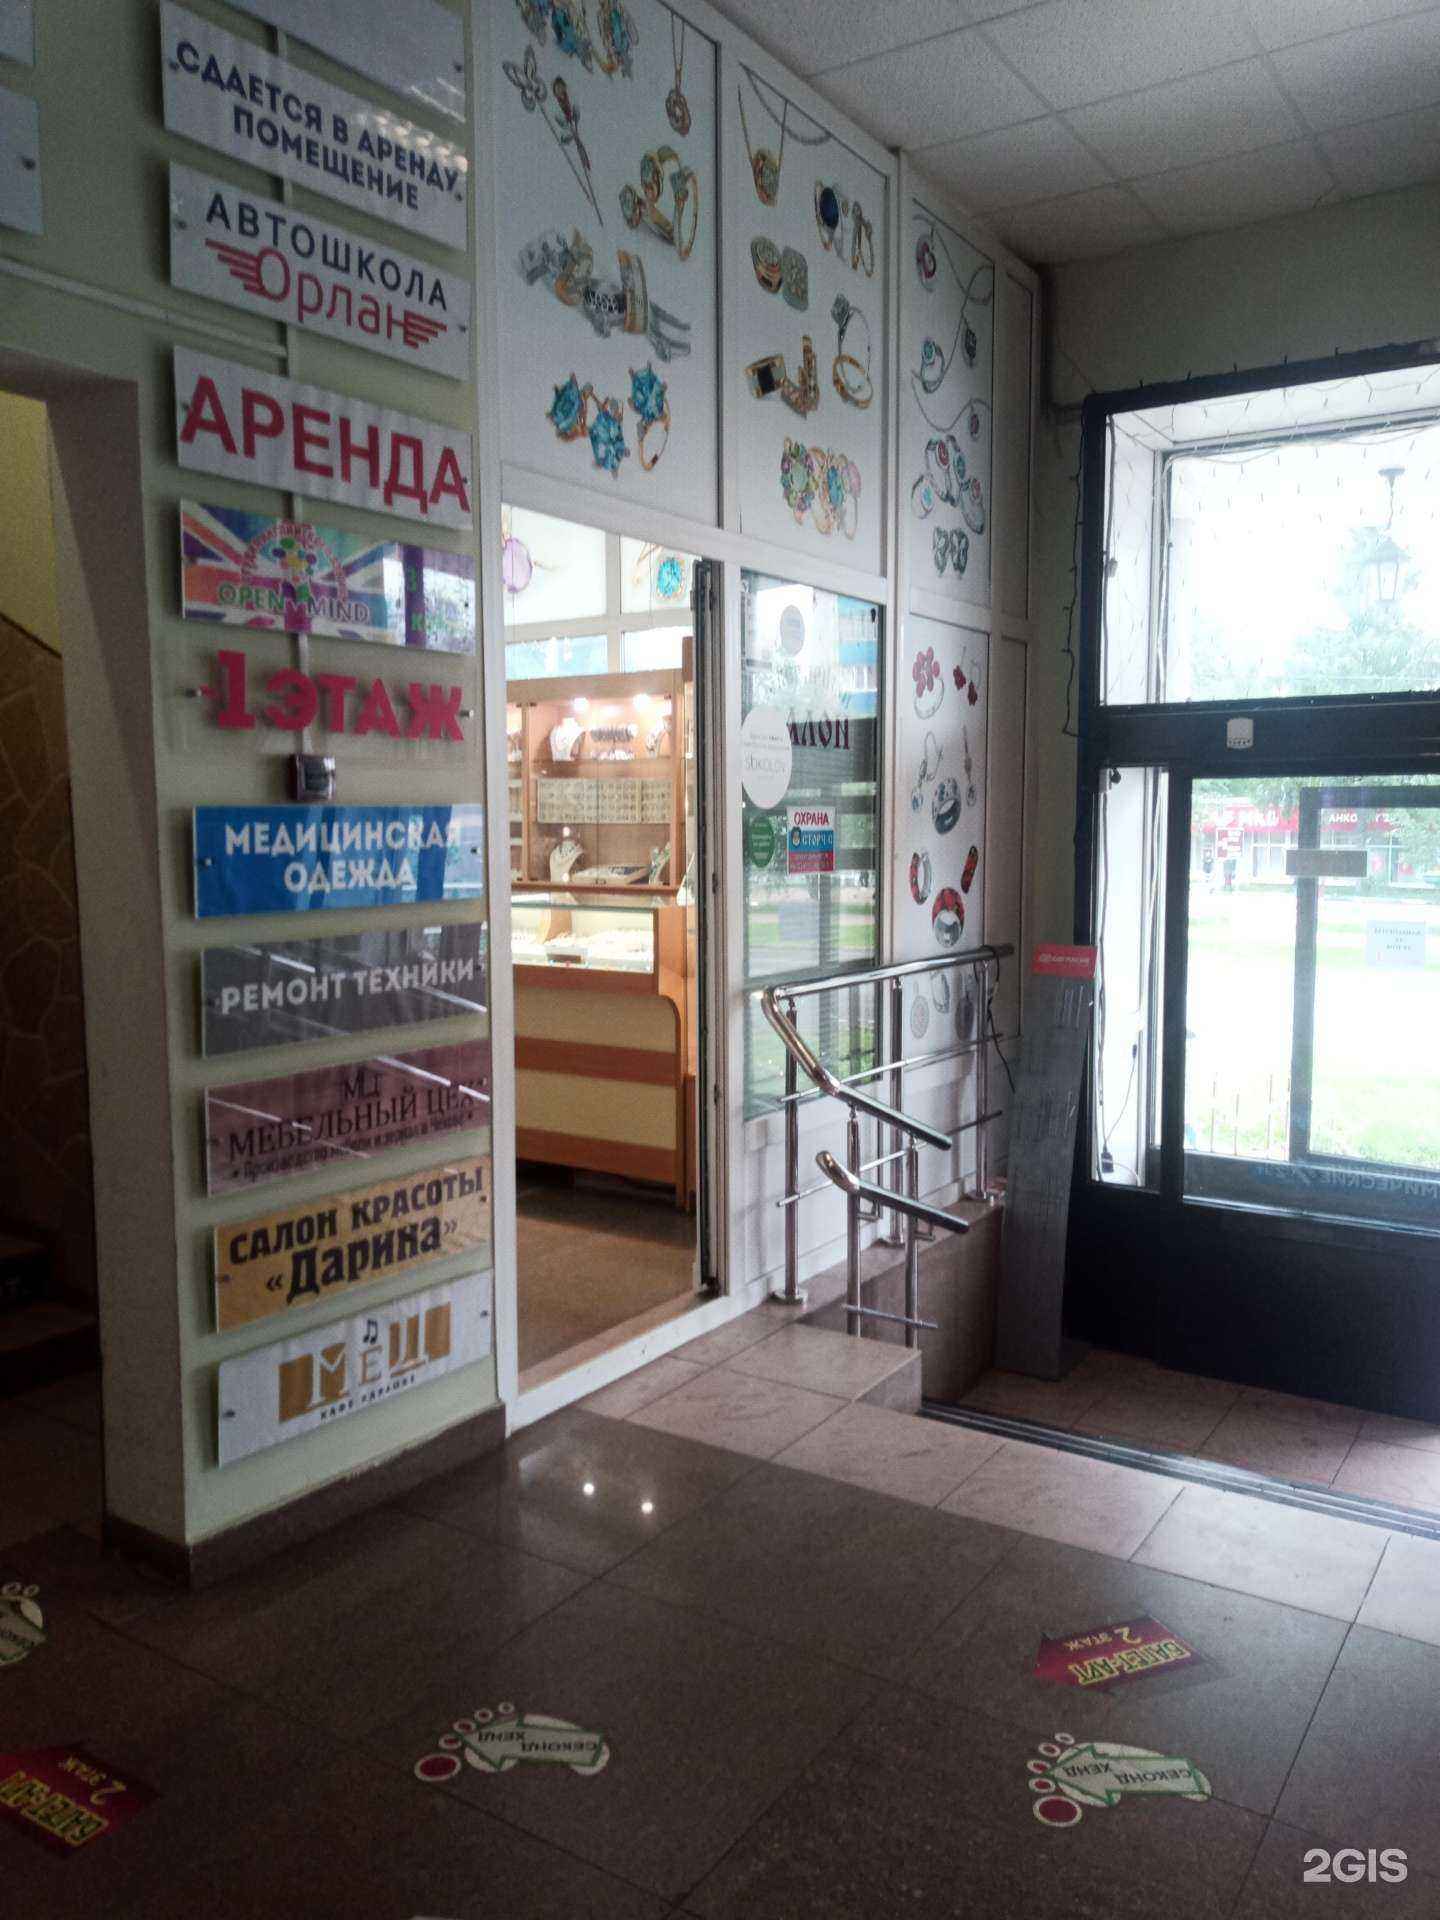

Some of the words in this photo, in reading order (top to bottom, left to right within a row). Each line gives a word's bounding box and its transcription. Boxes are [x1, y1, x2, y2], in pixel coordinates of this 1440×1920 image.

[176, 41, 322, 133] СДАЕТСЯ
[333, 114, 349, 145] В
[358, 130, 459, 192] АРЕНДУ
[233, 105, 419, 210] ПОМЕЩЕНИЕ
[206, 193, 447, 311] АВТОШКОЛА
[255, 246, 415, 346] Орлан
[179, 375, 471, 514] АРЕНДА
[218, 582, 285, 610] OPEN
[307, 596, 369, 622] MIND
[201, 650, 256, 730] 1
[265, 667, 464, 742] ЭТАЖ
[786, 707, 851, 751] АЛОН
[225, 821, 462, 855] МЕДИЦИНСКАЯ
[793, 811, 830, 827] ОХРАНА
[283, 856, 417, 893] ОДЕЖДА
[220, 972, 347, 1015] РЕМОНТ
[353, 957, 474, 996] ТЕХНИКИ
[228, 1085, 418, 1162] МЕБЕЛЬНЫЙ
[229, 1208, 338, 1265] САЛОН
[351, 1165, 483, 1232] КРАСОТЫ
[266, 1215, 458, 1305] «Дарина»
[1114, 1626, 1142, 1645] 2
[1113, 1766, 1194, 1786] СЕКОНД
